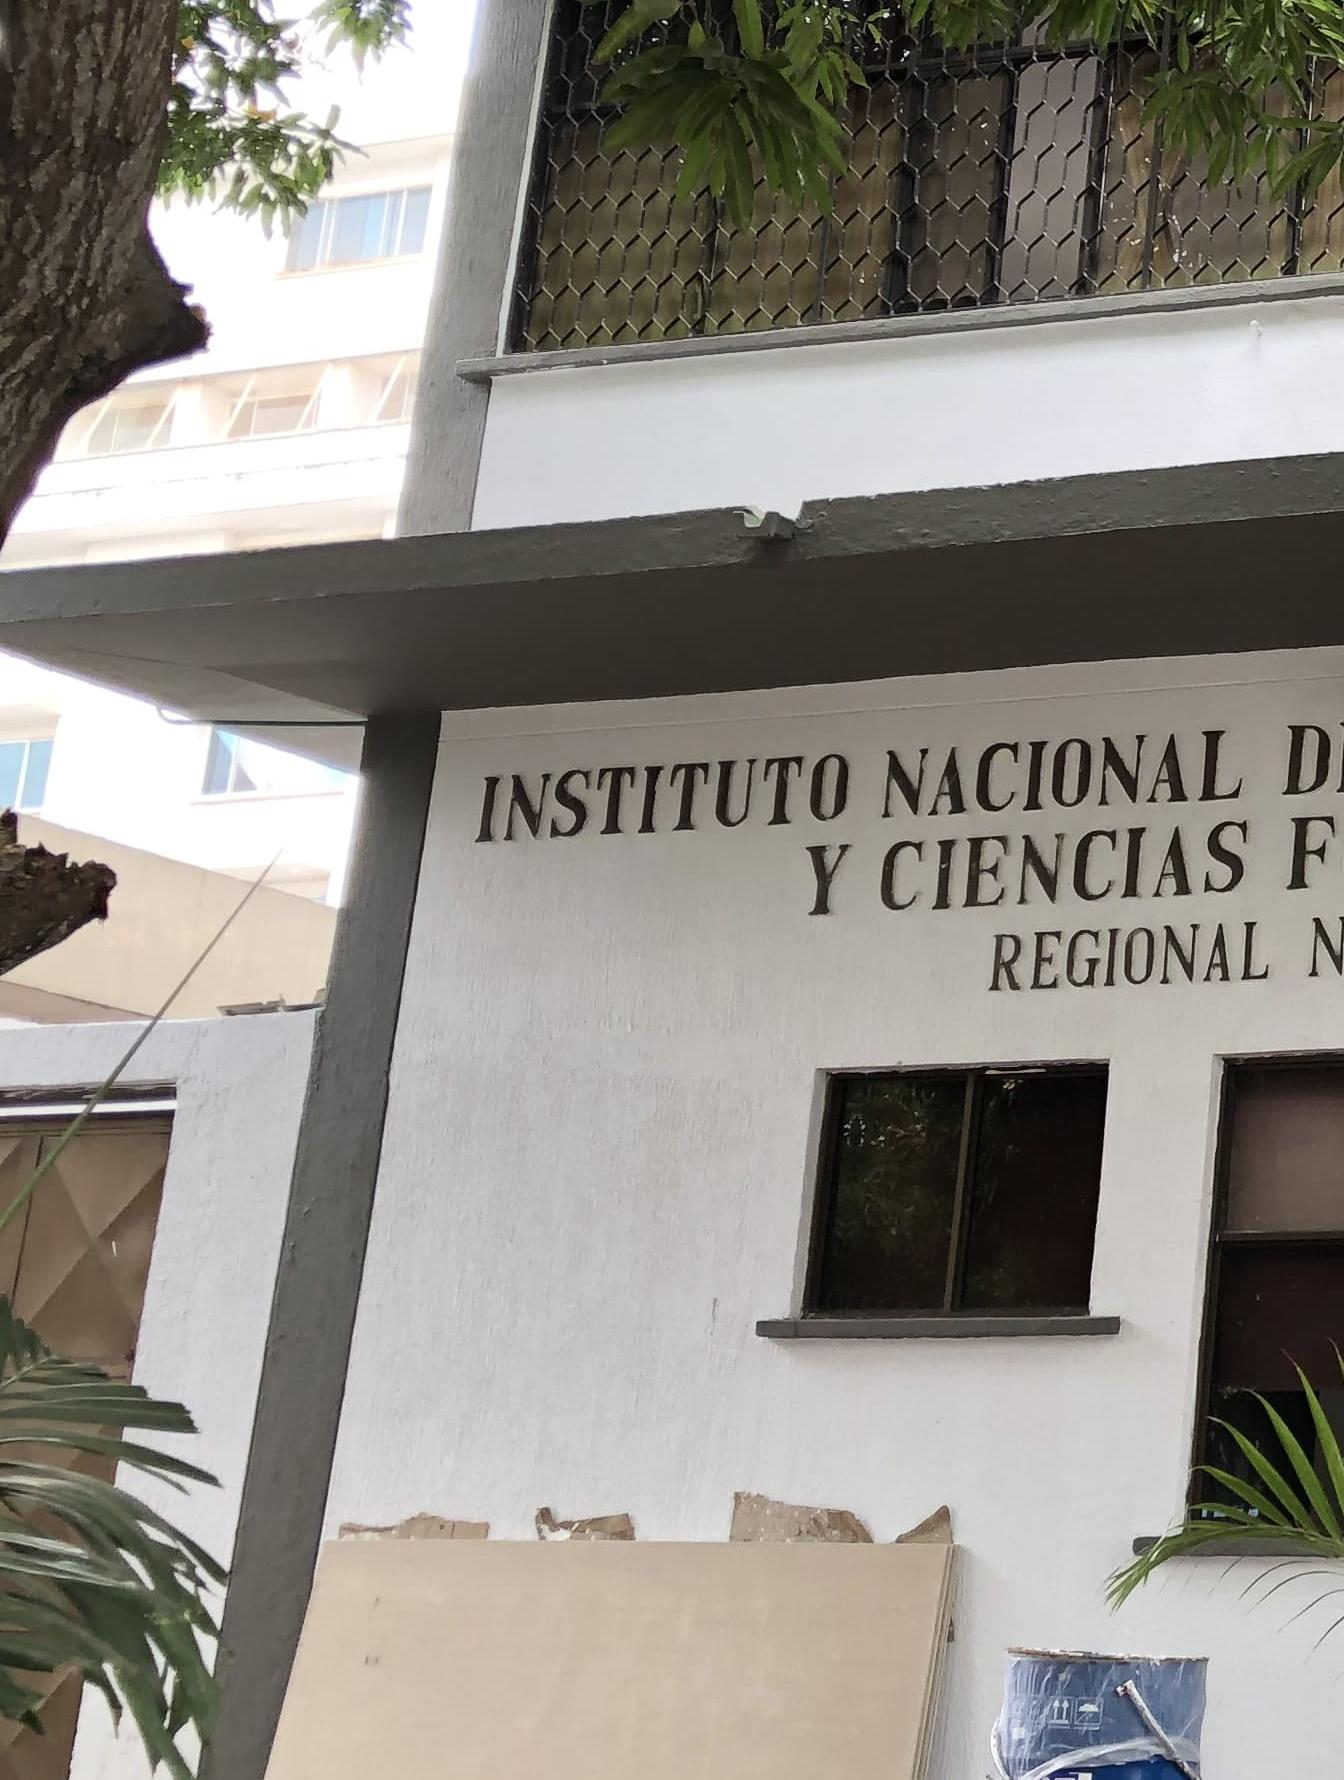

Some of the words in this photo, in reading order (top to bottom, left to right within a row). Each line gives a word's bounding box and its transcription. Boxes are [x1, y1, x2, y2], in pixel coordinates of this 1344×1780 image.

[475, 752, 851, 843] INSTITUTO
[880, 729, 1243, 819] NACIONAL
[805, 842, 851, 916] Y
[880, 819, 1249, 911] CIENCIAS
[988, 921, 1269, 992] REGIONAL
